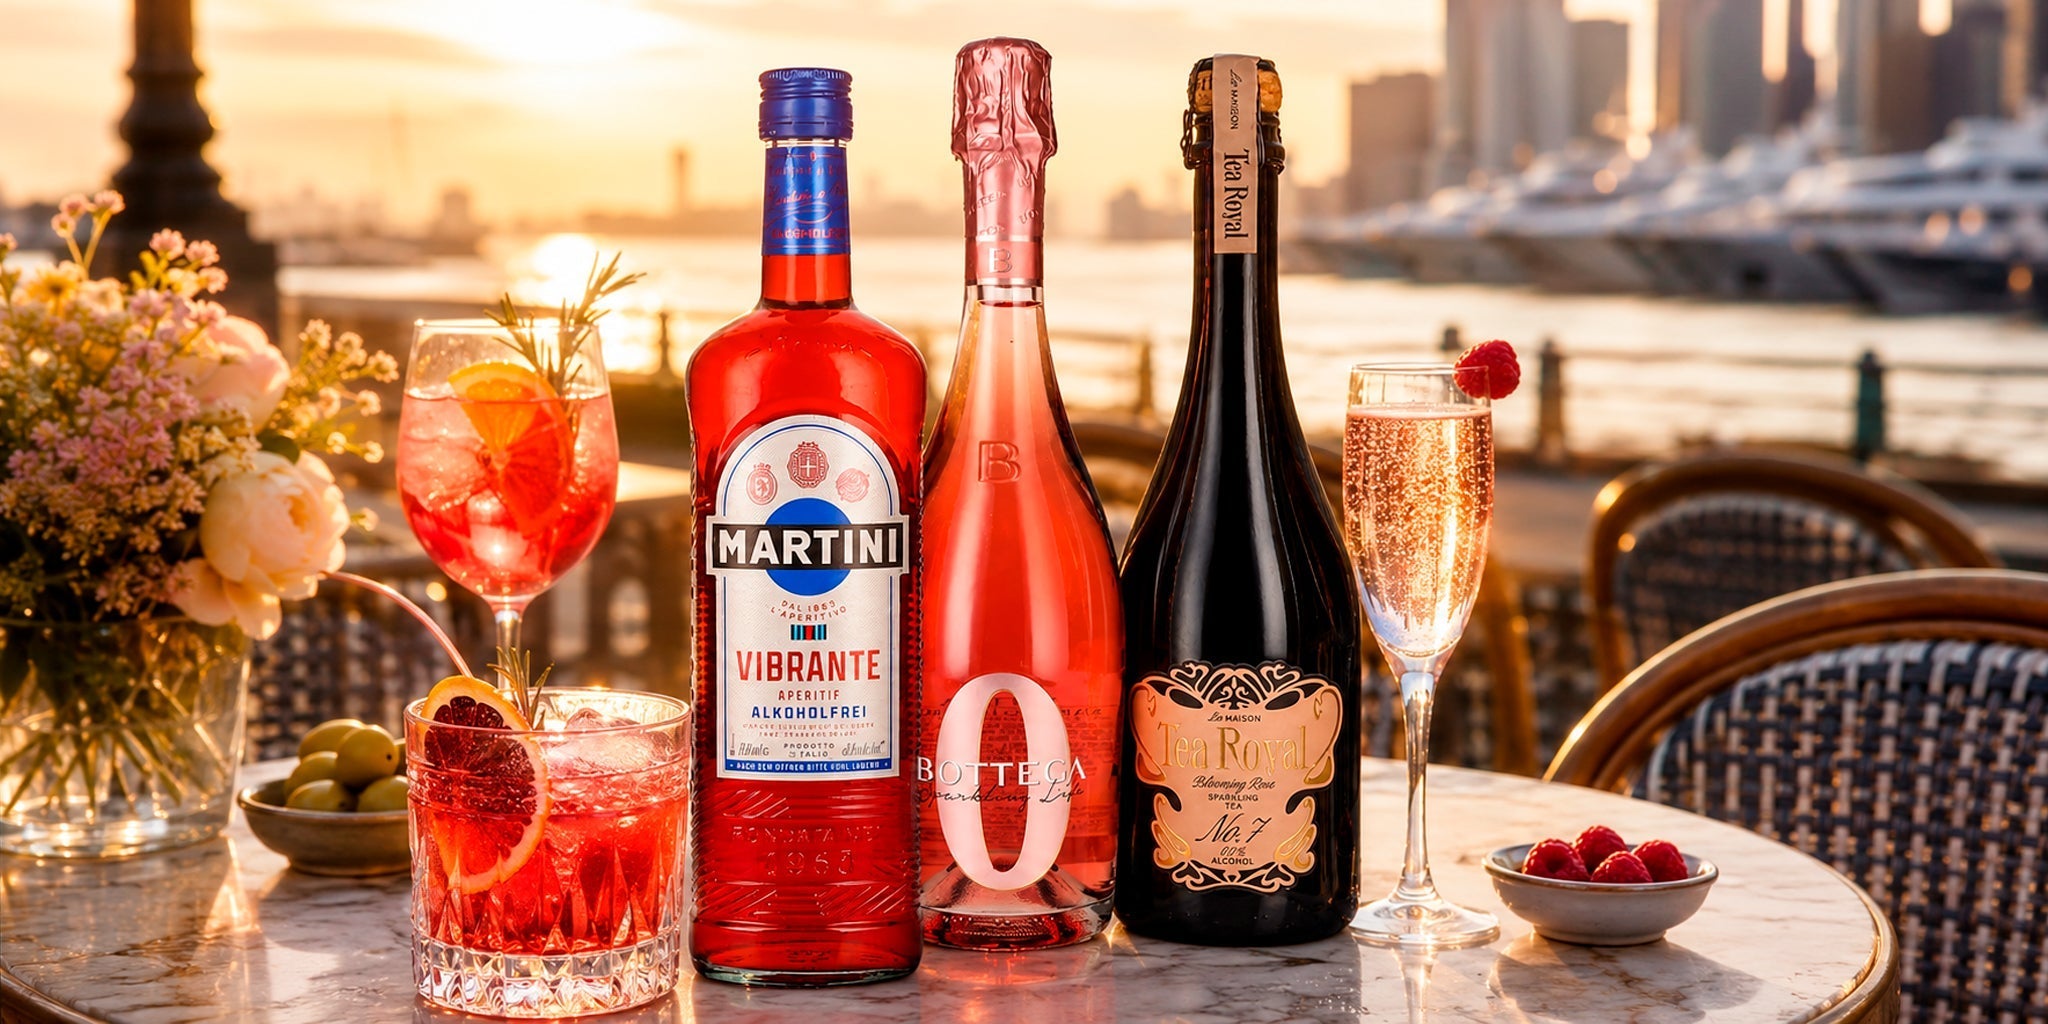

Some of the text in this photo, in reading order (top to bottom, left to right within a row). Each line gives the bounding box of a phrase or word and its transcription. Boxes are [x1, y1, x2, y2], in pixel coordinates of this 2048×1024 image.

[1223, 148, 1249, 240] Tea Royal
[987, 246, 1013, 273] B
[978, 440, 1021, 483] B
[719, 527, 898, 566] MARTINI
[736, 649, 882, 682] VIBRANTE
[778, 690, 840, 701] APERITIF
[751, 705, 867, 720] ALKOHOLFREI
[1225, 714, 1262, 723] MAISON
[1157, 721, 1207, 770] Tea
[1216, 725, 1310, 776] Royal
[916, 755, 1087, 787] BOTTEGA
[1192, 775, 1247, 795] Blooming
[1208, 793, 1259, 801] SPARKLING
[1225, 802, 1243, 810] TEA
[1195, 813, 1272, 843] No. 7
[1211, 857, 1254, 865] ALCOHOL
